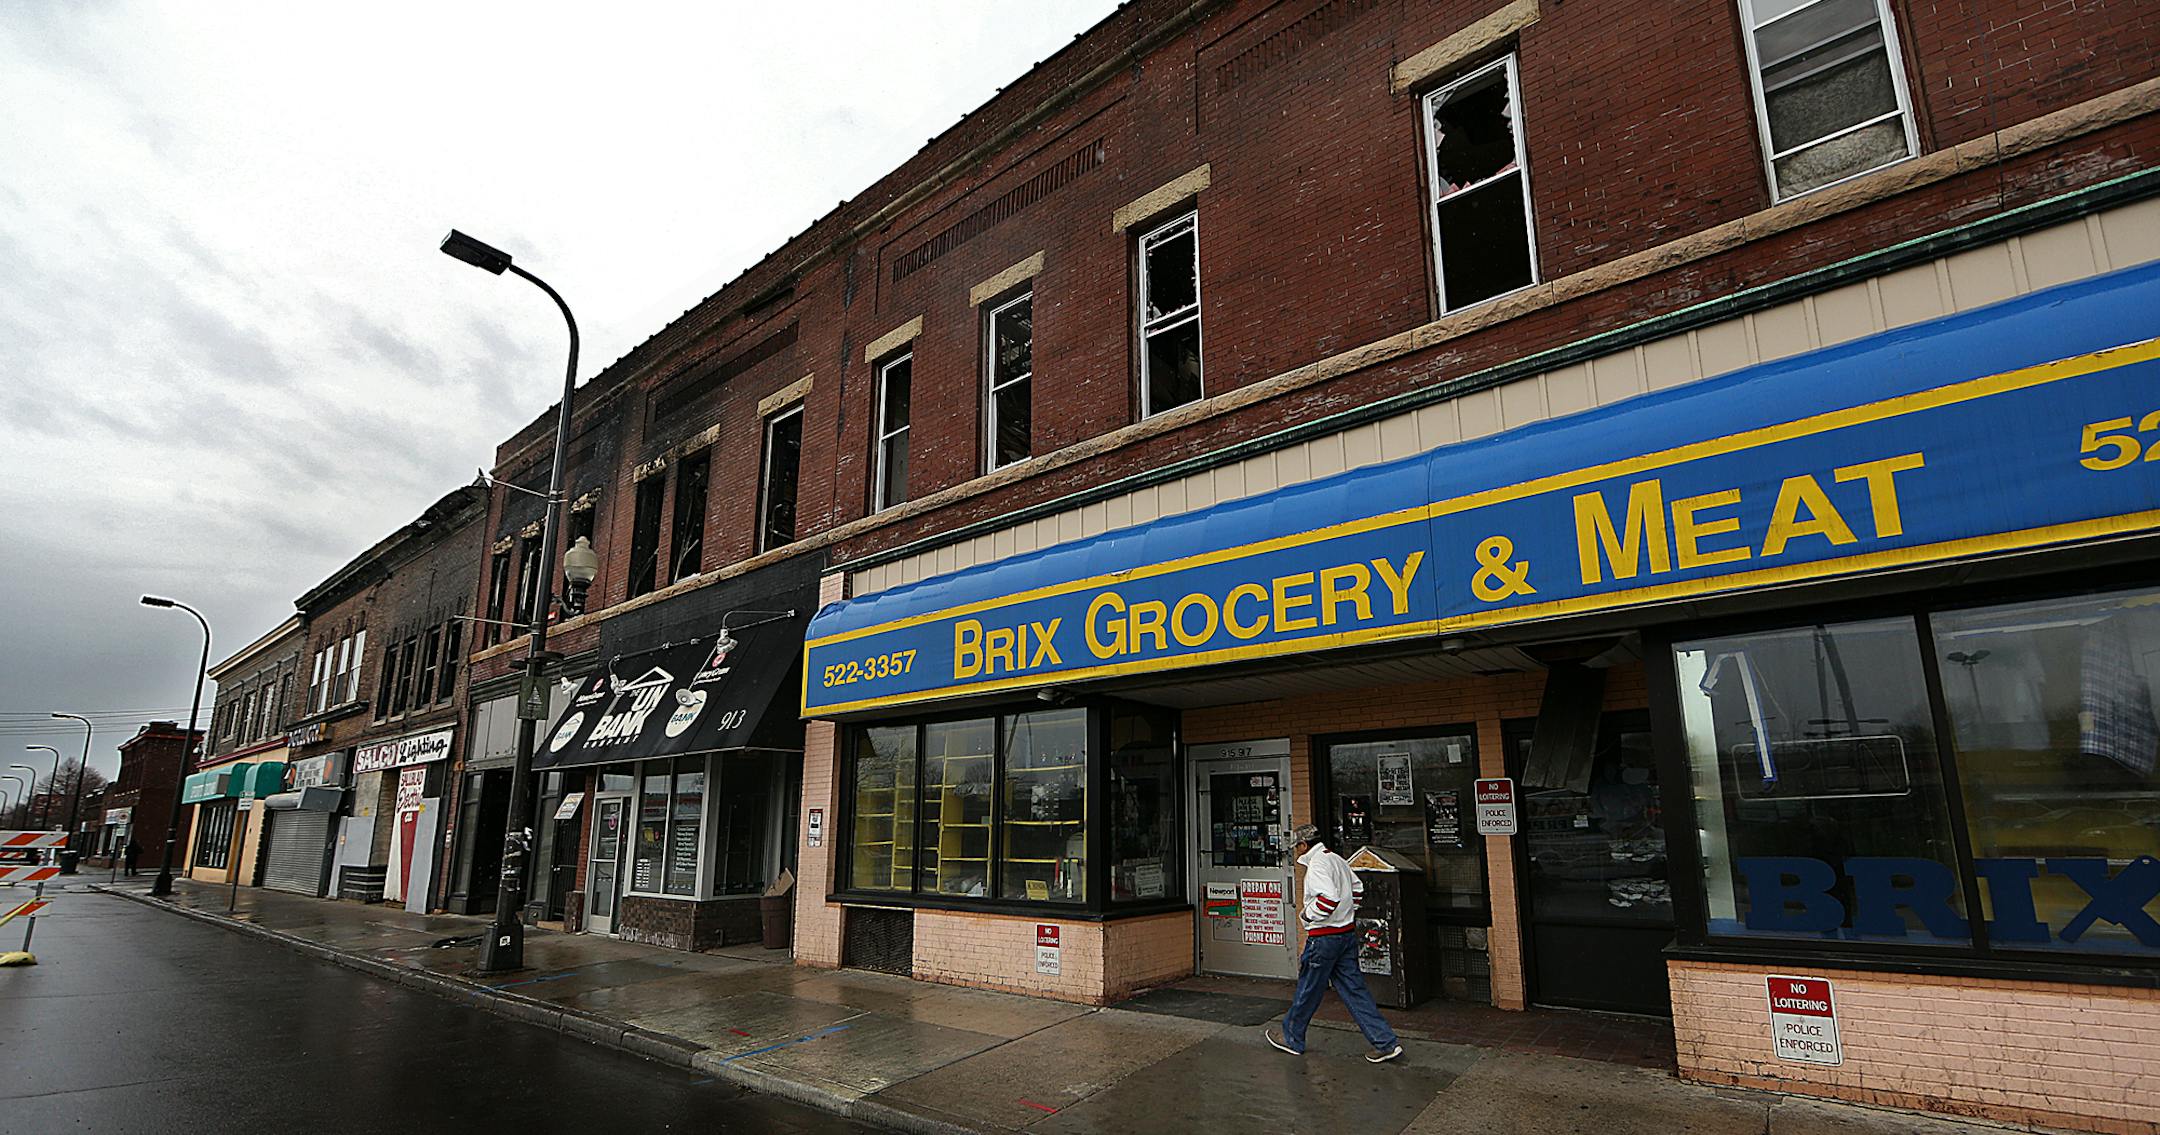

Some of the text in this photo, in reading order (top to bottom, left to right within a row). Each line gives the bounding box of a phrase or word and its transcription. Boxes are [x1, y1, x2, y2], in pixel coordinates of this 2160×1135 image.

[953, 452, 1926, 680] BRIX GROCERY & MEAT
[823, 649, 917, 688] 522-3357
[631, 683, 671, 712] UN
[587, 707, 656, 741] BANK
[717, 709, 747, 731] 913
[1488, 783, 1499, 791] NO
[1479, 792, 1510, 801] LOITERING
[1485, 809, 1506, 817] POLICE
[1209, 887, 1235, 896] Newport
[1737, 855, 2160, 946] BRIX
[1790, 983, 1808, 995] NO
[1773, 997, 1829, 1013] LOITERING
[1785, 1023, 1824, 1037] POLICE
[1780, 1038, 1834, 1053] ENFORCED
